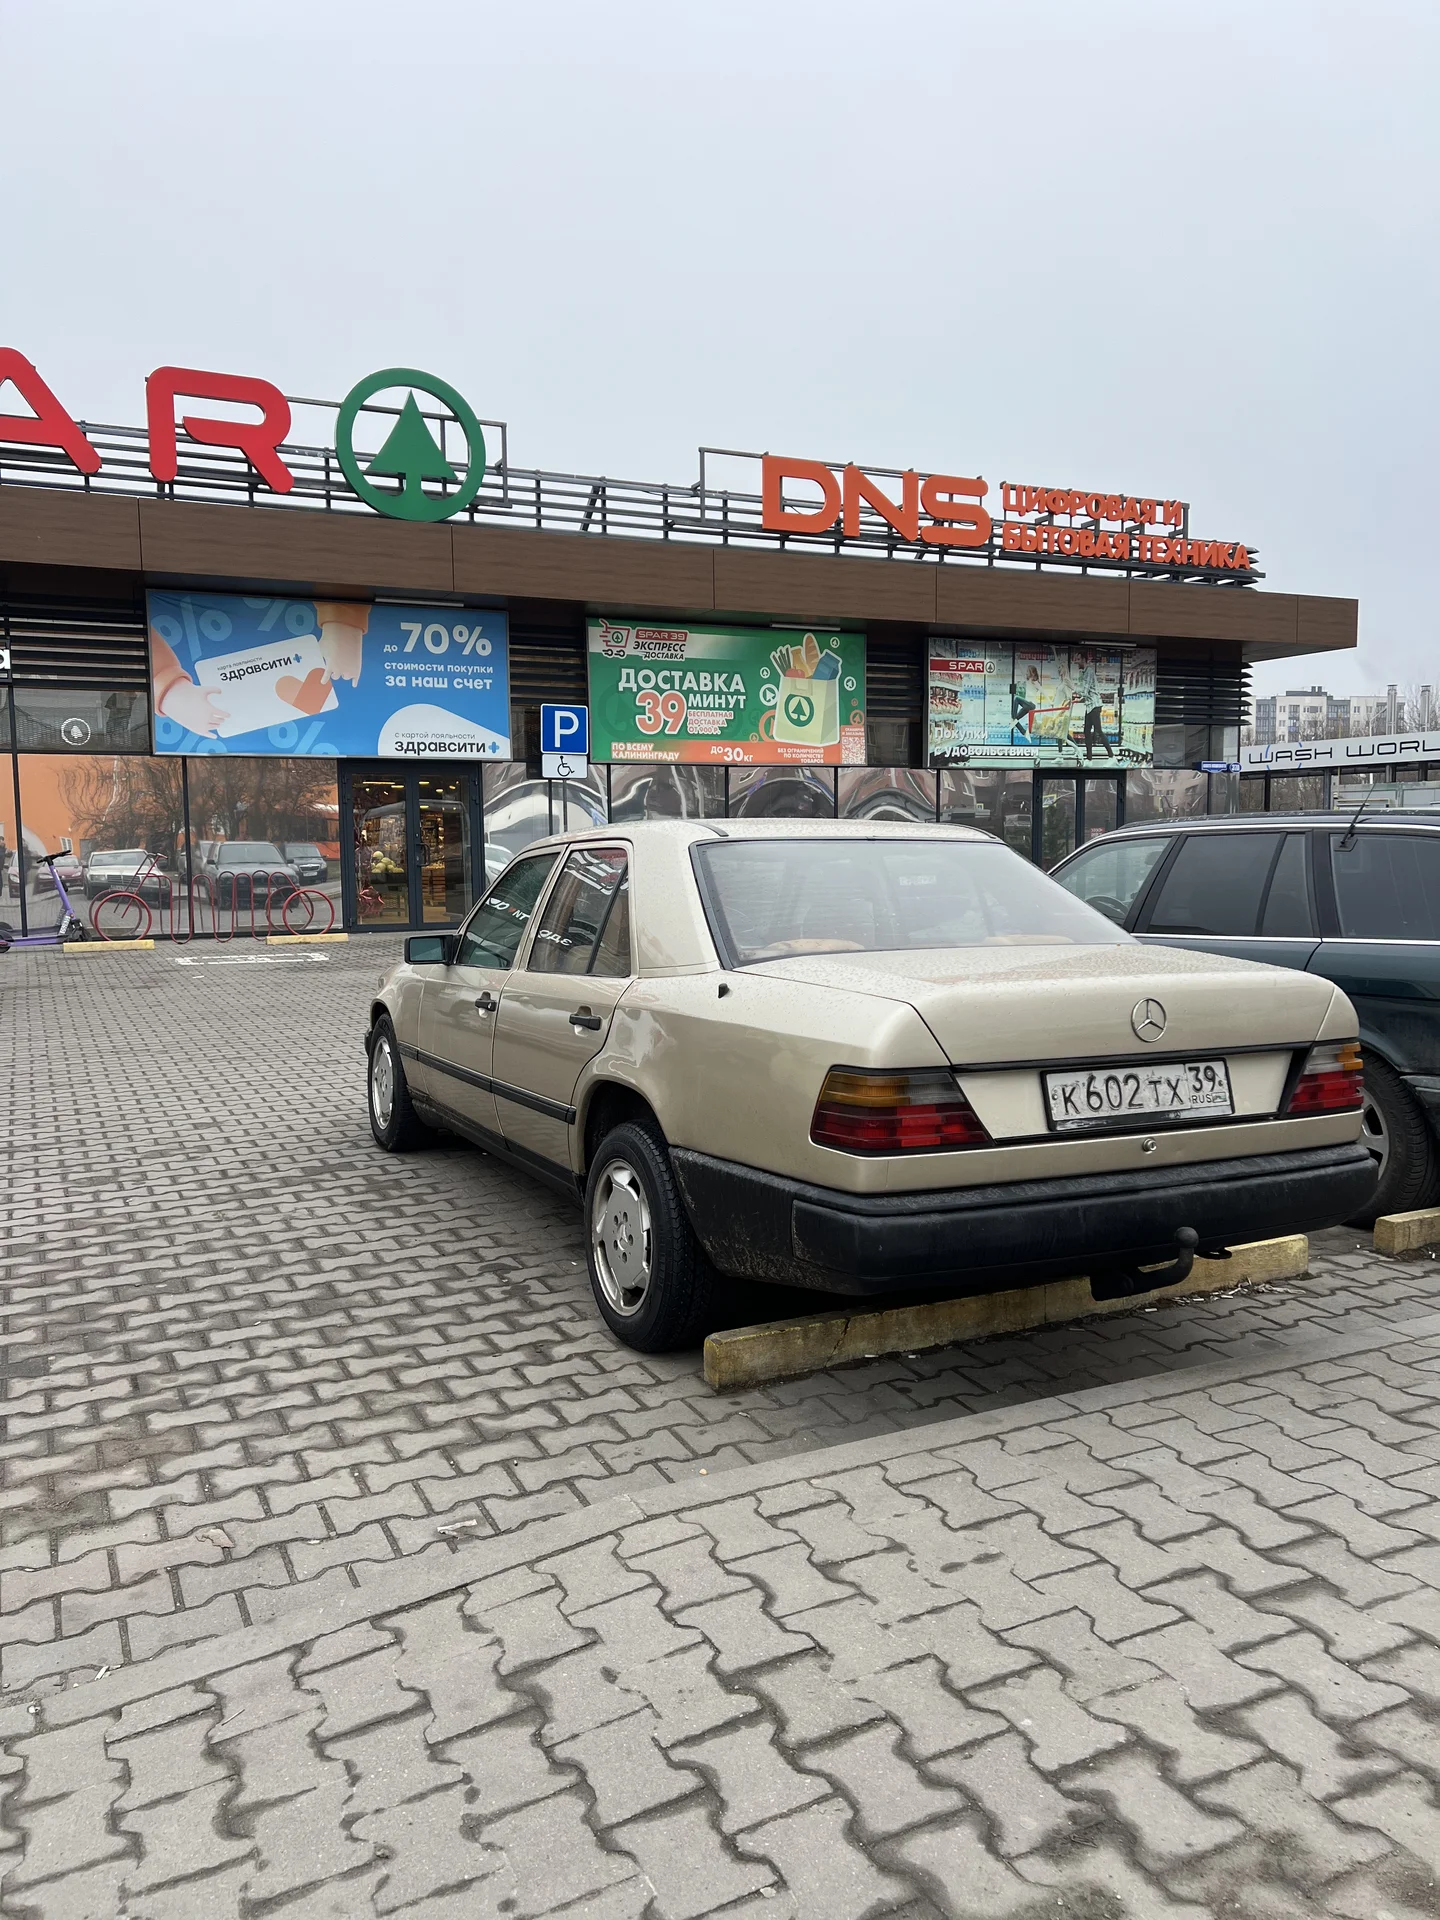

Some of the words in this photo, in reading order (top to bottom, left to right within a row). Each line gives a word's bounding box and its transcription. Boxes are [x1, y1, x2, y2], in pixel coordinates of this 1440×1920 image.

[762, 455, 991, 547] DNS
[1002, 483, 1156, 525] ЦИФРОВАЯ
[1163, 500, 1181, 526] И
[1002, 521, 1130, 560] БЫТОВАЯ
[1135, 534, 1250, 570] ТЕХНИКА
[383, 645, 398, 653] до
[400, 622, 492, 656] 70%
[638, 631, 669, 640] SPAR
[670, 632, 686, 641] 39
[633, 640, 686, 652] ЭКСПРЕСС
[644, 651, 684, 660] ДОСТАВКА
[220, 657, 292, 681] здравсити
[384, 662, 444, 672] стоимости
[447, 664, 494, 675] покупки
[948, 661, 983, 671] SPAR
[385, 675, 407, 687] за
[411, 676, 448, 689] наш
[453, 678, 493, 690] счет
[618, 668, 746, 692] ДОСТАВКА
[688, 693, 746, 709] МИНУТ
[635, 689, 687, 734] 39
[688, 710, 733, 718] БЕСПЛАТНАЯ
[401, 732, 429, 740] картой
[554, 710, 580, 748] P
[934, 727, 988, 741] Покупки
[395, 740, 486, 756] здравсити
[611, 742, 625, 750] ПО
[626, 742, 654, 751] ВСЕМУ
[710, 746, 723, 755] ДО
[943, 746, 1039, 758] удовольствием
[612, 751, 680, 761] КАЛИНИНГРАДУ
[1248, 747, 1333, 764] WASH
[1187, 1065, 1217, 1093] 39
[1190, 1094, 1212, 1105] RUS
